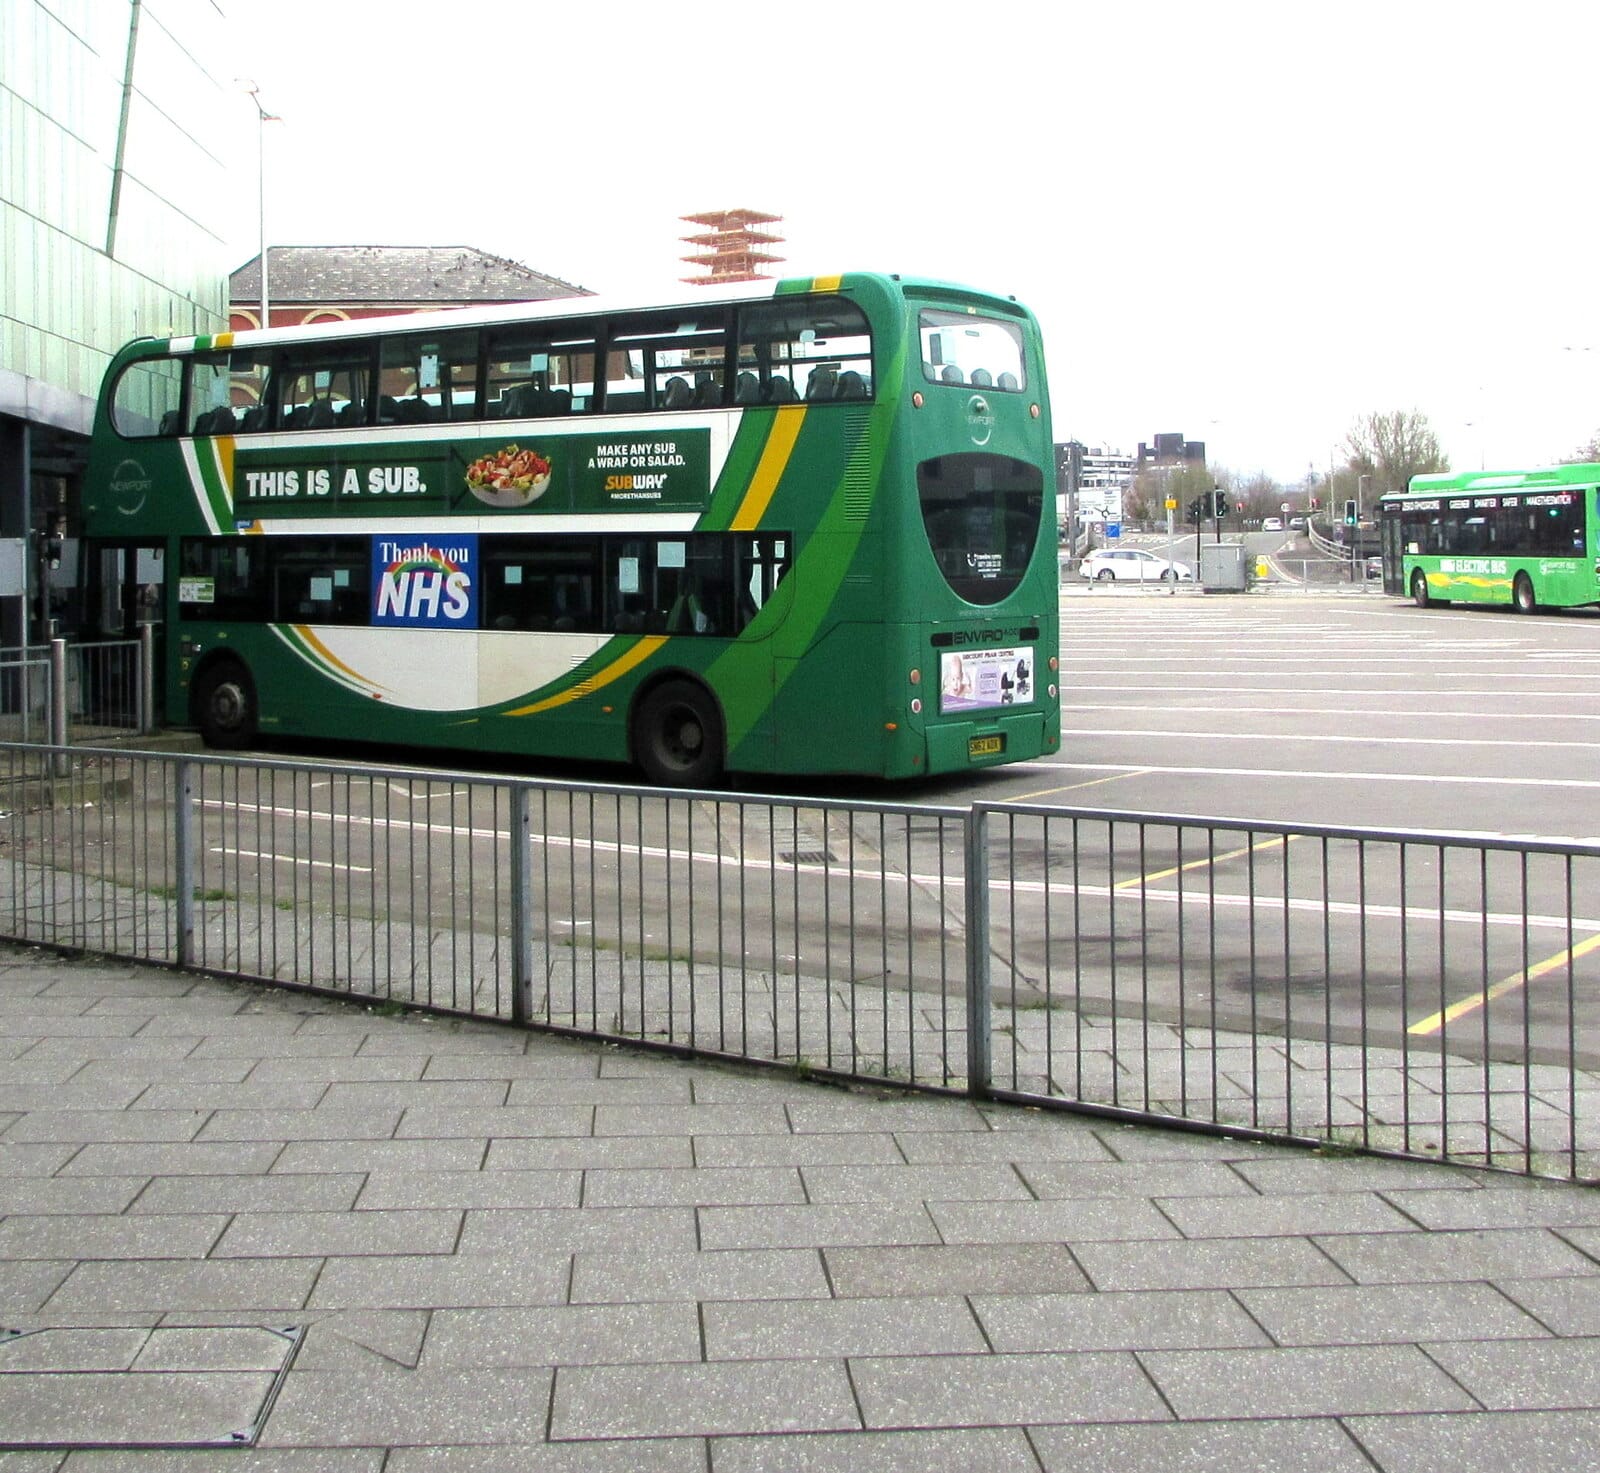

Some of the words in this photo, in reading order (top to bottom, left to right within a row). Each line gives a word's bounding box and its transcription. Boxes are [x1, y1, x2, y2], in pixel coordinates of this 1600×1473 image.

[597, 445, 628, 457] MAKE
[629, 443, 653, 455] ANY
[654, 442, 676, 454] SUB
[588, 458, 595, 468] A
[597, 457, 628, 468] WRAP
[630, 456, 646, 467] OR
[647, 455, 686, 466] SALAD.
[246, 470, 299, 497] THIS
[307, 469, 330, 495] IS
[342, 468, 360, 494] A
[368, 467, 427, 494] SUB.
[605, 473, 668, 491] SUBWAY
[380, 542, 433, 563] Thank
[439, 548, 469, 568] you
[1455, 560, 1490, 574] ELECTRIC
[1491, 560, 1507, 574] BUS
[377, 571, 471, 619] NHS
